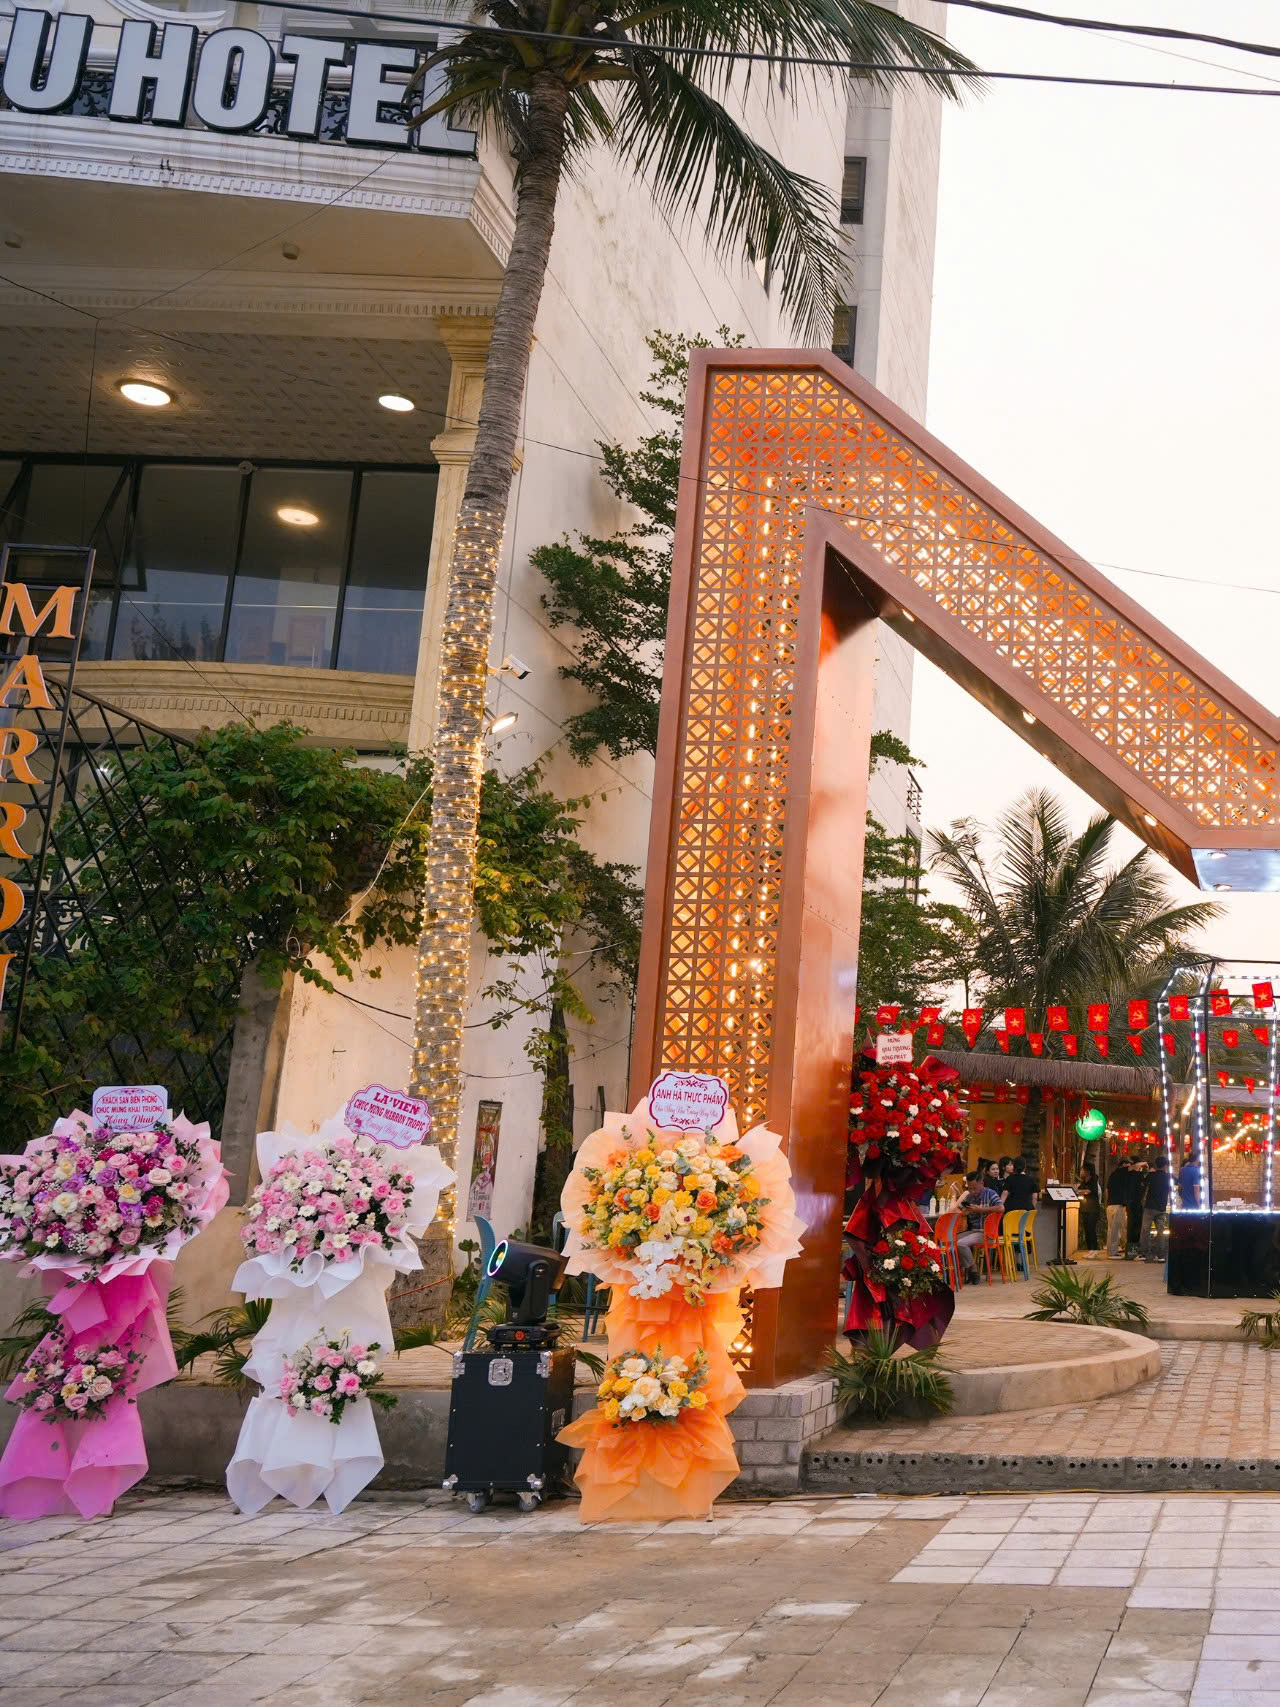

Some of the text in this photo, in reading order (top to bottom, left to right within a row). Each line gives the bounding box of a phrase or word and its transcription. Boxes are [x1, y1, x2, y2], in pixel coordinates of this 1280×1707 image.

[108, 19, 478, 157] HOTEL
[0, 582, 81, 1010] MARR
[406, 1117, 426, 1131] TROPIC
[656, 1089, 672, 1100] ANH
[673, 1088, 682, 1101] HÀ
